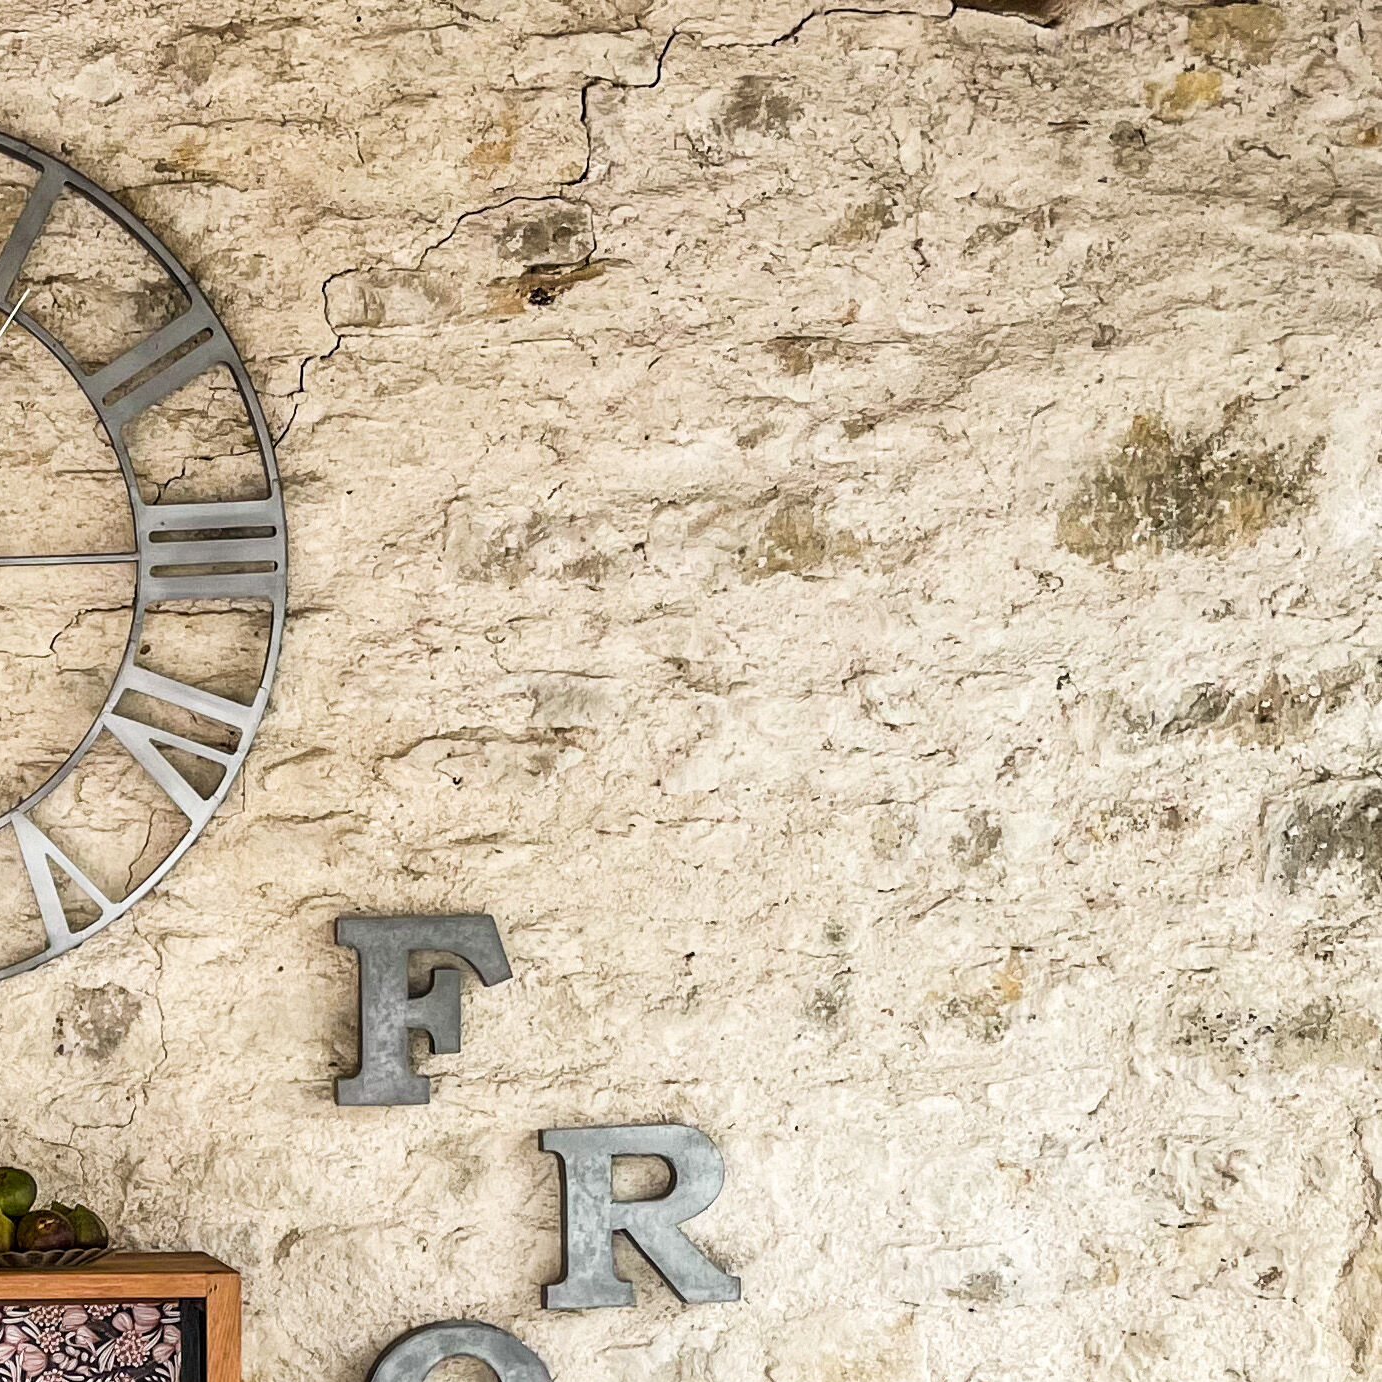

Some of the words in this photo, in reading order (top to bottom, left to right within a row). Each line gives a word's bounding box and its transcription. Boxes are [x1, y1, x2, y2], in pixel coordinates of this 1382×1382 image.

[81, 311, 232, 427] II
[139, 499, 283, 602] III
[13, 807, 122, 939] V
